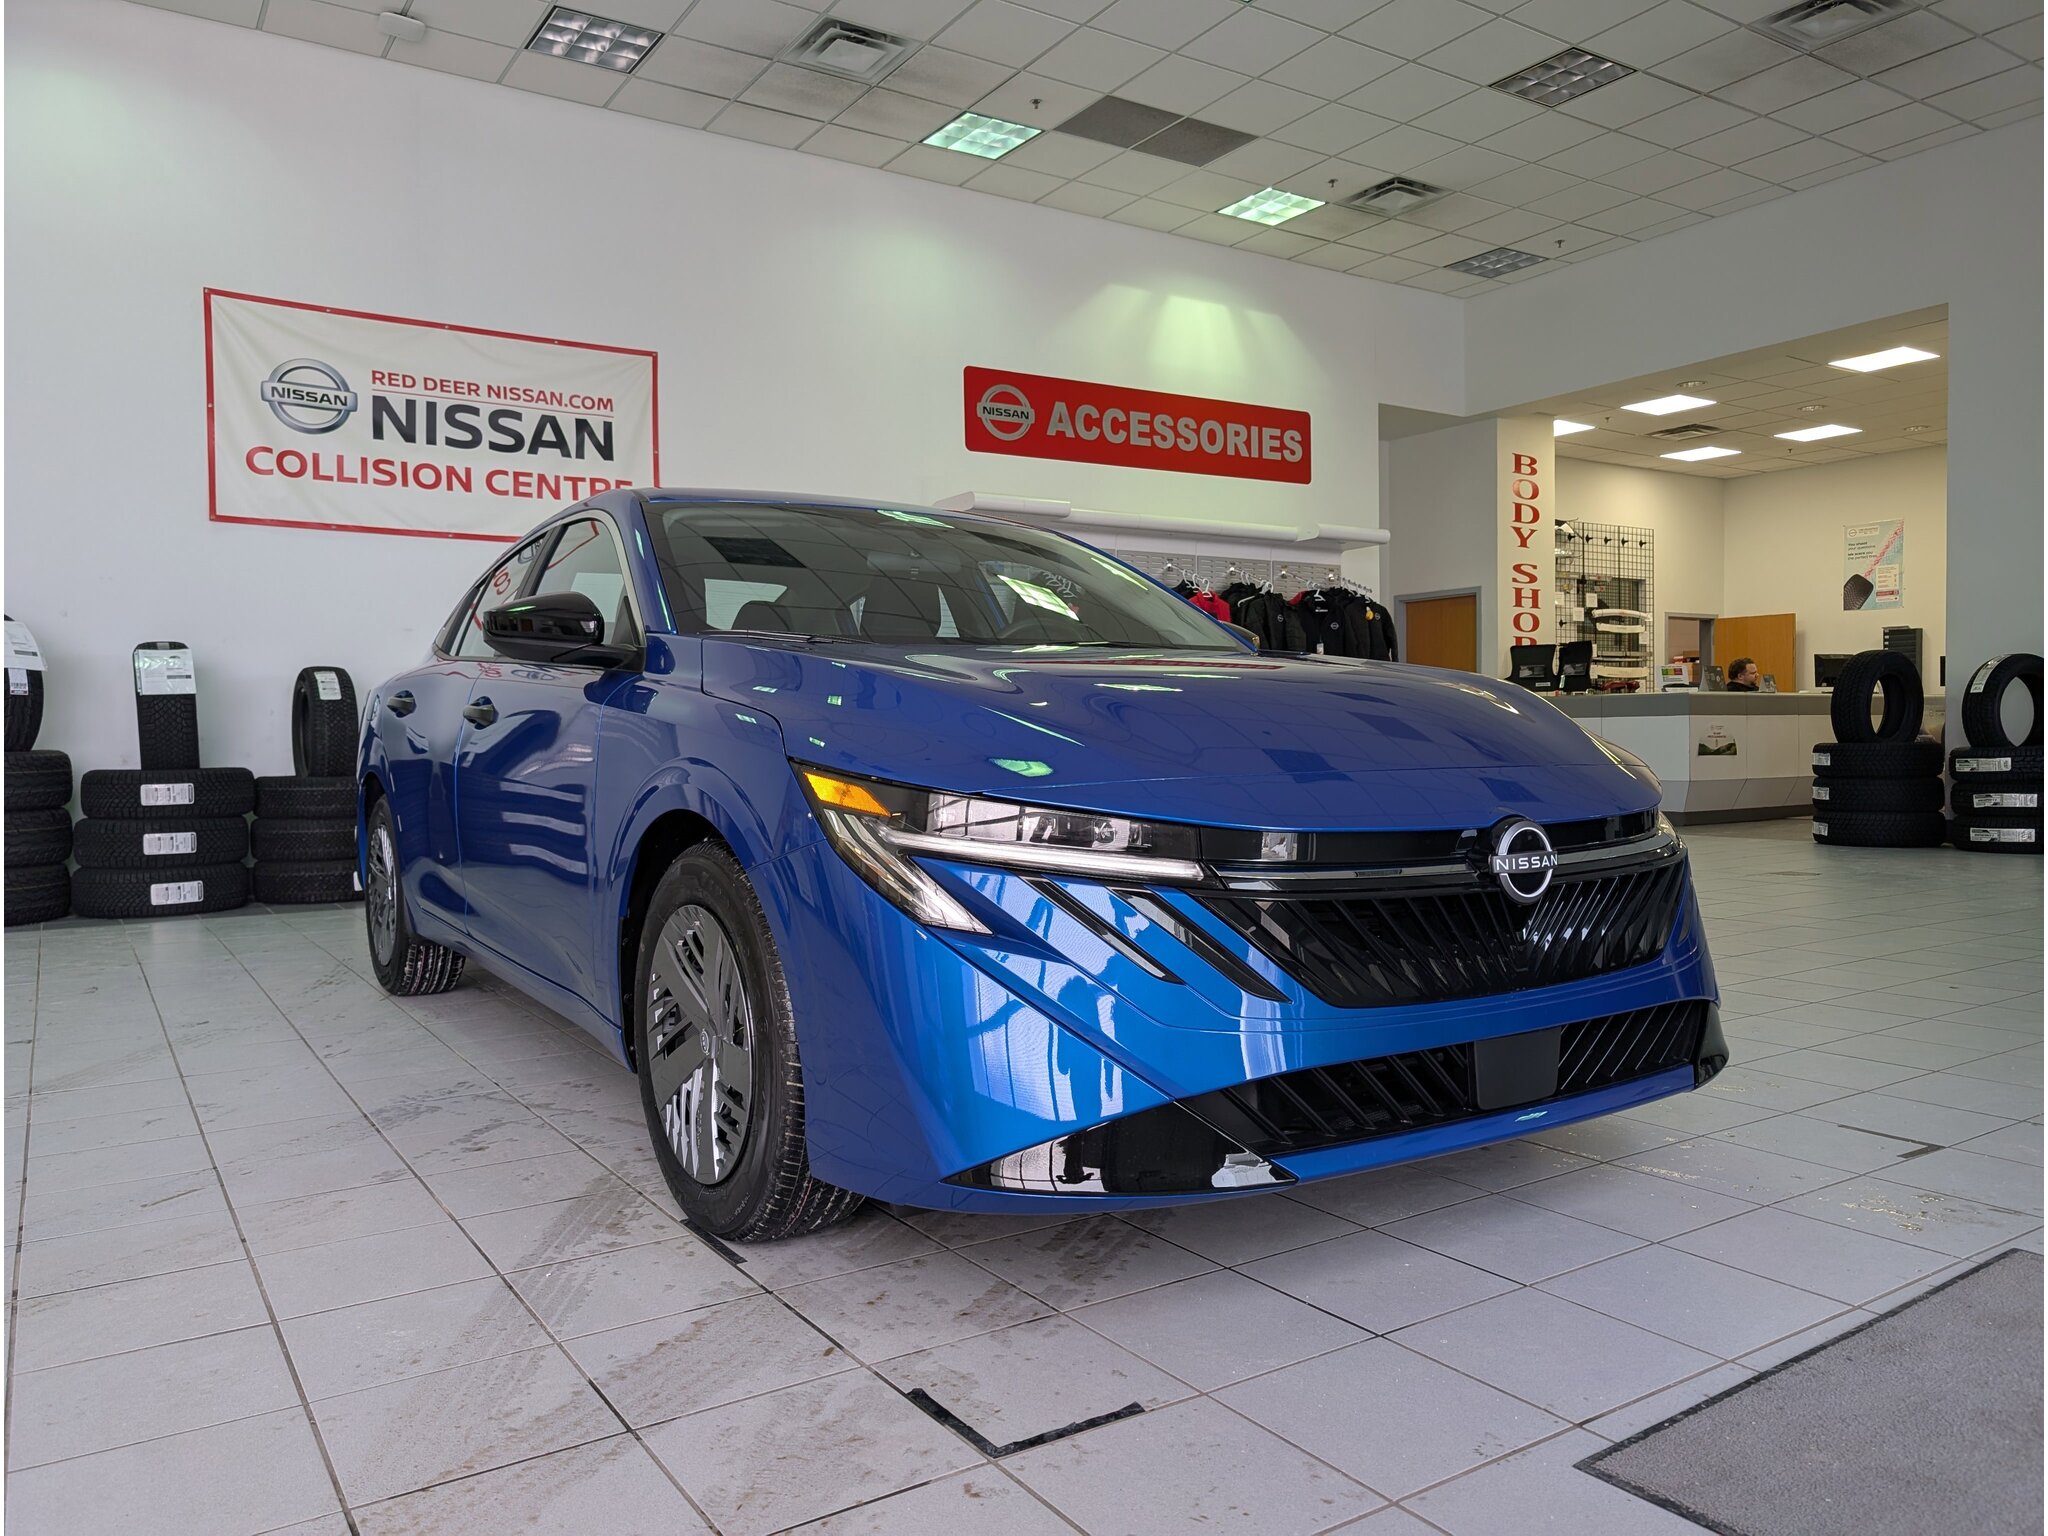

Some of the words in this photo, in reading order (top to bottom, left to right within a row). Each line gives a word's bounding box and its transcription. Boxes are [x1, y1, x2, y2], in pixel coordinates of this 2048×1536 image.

[271, 386, 347, 407] NISSAN
[371, 369, 417, 389] RED
[423, 376, 481, 397] DEER
[487, 384, 614, 412] NISSAN.COM
[982, 406, 1030, 420] NISSAN
[371, 395, 615, 462] NISSAN
[1046, 401, 1303, 463] ACCESSORIES
[245, 446, 473, 493] COLLISION
[1510, 452, 1540, 549] BODY
[1496, 853, 1558, 871] NISSAN
